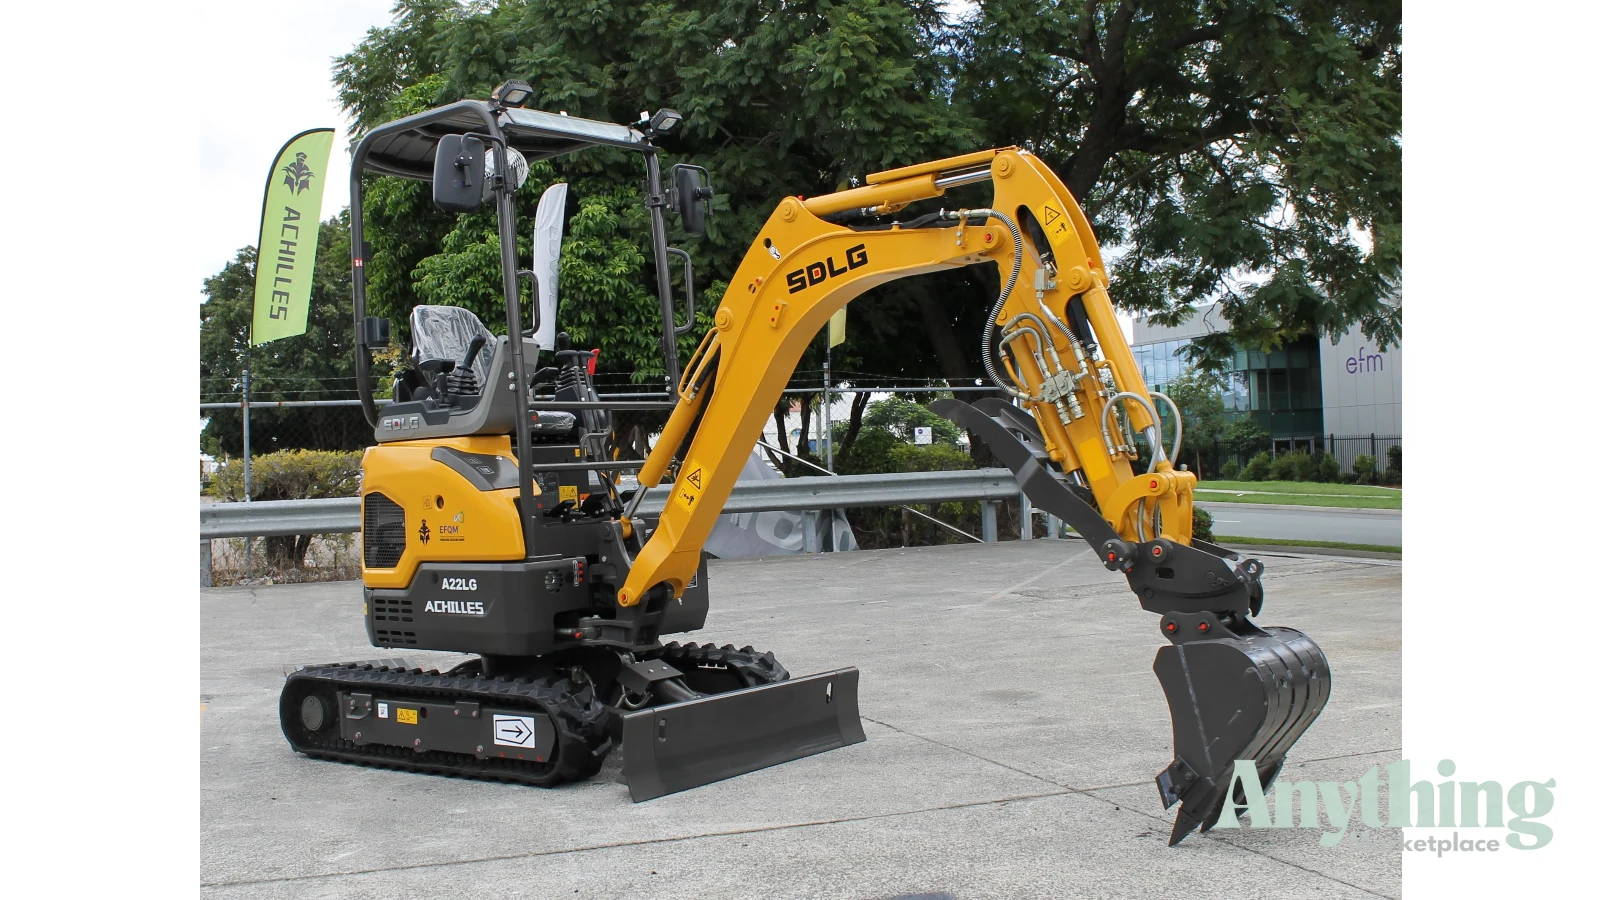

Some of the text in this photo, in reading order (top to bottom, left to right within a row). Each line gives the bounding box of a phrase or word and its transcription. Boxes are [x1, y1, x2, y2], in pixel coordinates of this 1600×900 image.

[269, 206, 301, 321] ACHILLES
[786, 243, 869, 295] SDLG
[1345, 346, 1383, 374] efm
[383, 416, 419, 431] SDLG
[439, 525, 459, 534] EFQM
[441, 577, 478, 591] A22LG
[424, 600, 485, 615] ACHILLES
